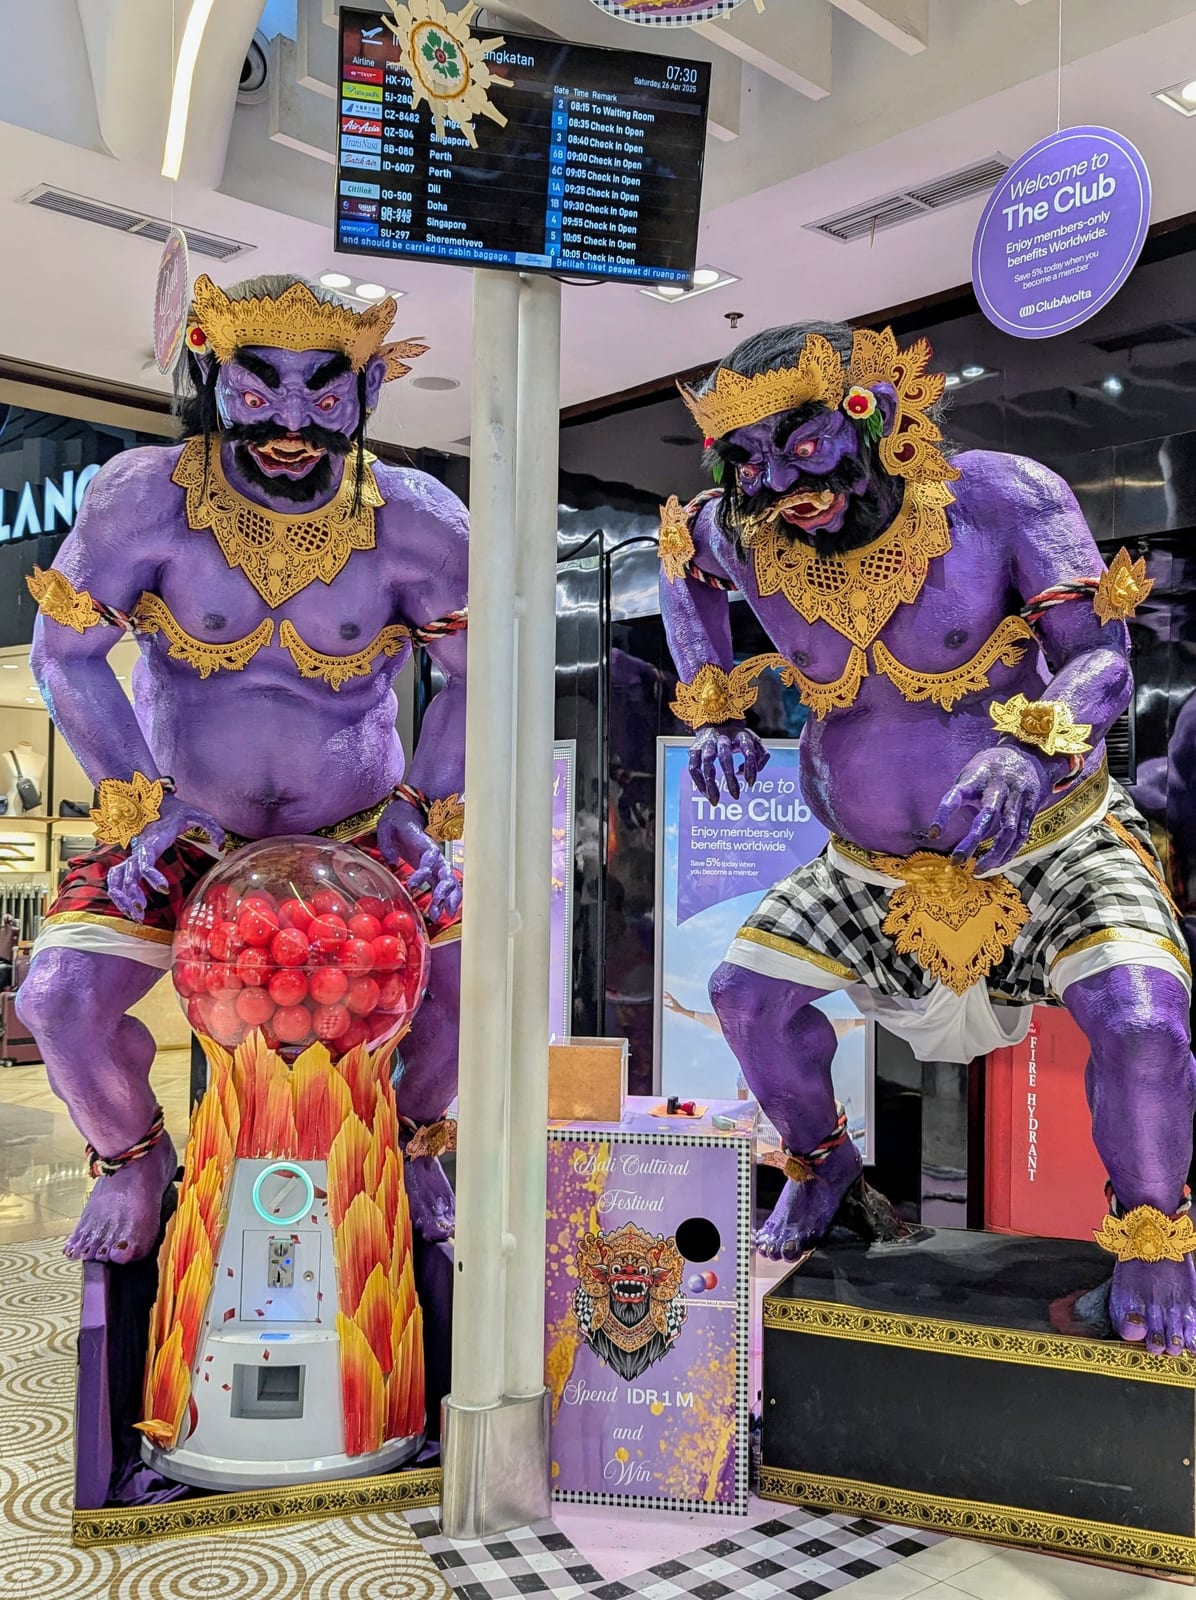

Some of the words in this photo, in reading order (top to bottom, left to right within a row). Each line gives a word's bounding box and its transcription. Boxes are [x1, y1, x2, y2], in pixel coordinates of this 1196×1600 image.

[352, 56, 374, 67] Airline
[666, 66, 698, 83] 07:30
[554, 86, 569, 95] Gate
[574, 88, 589, 97] Time
[592, 91, 617, 102] Remark
[662, 81, 669, 89] 26
[670, 83, 681, 91] Apr
[682, 84, 696, 93] 2025
[385, 92, 412, 104] 5J-280
[385, 110, 419, 123] CZ-8482
[559, 101, 563, 109] 2
[571, 101, 589, 112] 08:15
[592, 105, 601, 114] To
[603, 107, 631, 120] Waiting
[633, 112, 655, 122] Room
[384, 127, 414, 140] QZ-504
[569, 118, 589, 128] 08:35
[591, 122, 614, 133] Check
[616, 125, 623, 134] In
[625, 127, 644, 137] Open
[430, 132, 470, 146] Singapore
[568, 135, 588, 146] 08:40
[590, 138, 613, 149] Check
[615, 142, 622, 150] In
[624, 143, 643, 154] Open
[384, 144, 413, 156] 8B-080
[430, 150, 452, 162] Perth
[383, 161, 415, 173] ID-6007
[553, 150, 563, 158] 6B
[567, 152, 587, 162] 09:00
[589, 155, 612, 166] Check
[614, 158, 621, 167] In
[623, 160, 642, 170] Open
[429, 167, 452, 178] Perth
[552, 167, 562, 175] 6C
[566, 168, 586, 178] 09:05
[588, 172, 611, 182] Check
[613, 174, 619, 183] In
[622, 176, 640, 186] Open
[1011, 161, 1088, 200] Welcome
[1091, 153, 1108, 170] to
[381, 189, 412, 201] QG-500
[428, 184, 441, 193] Dili
[552, 183, 560, 191] 1A
[565, 184, 585, 194] 09:25
[586, 188, 610, 198] Check
[612, 191, 618, 199] In
[620, 192, 639, 202] Open
[427, 201, 447, 212] Doha
[551, 199, 559, 208] 1B
[564, 200, 584, 210] 09:30
[585, 204, 608, 214] Check
[610, 207, 617, 215] In
[619, 208, 638, 218] Open
[1002, 201, 1049, 231] The
[1054, 173, 1116, 212] Club
[427, 217, 466, 230] Singapore
[563, 217, 583, 227] 09:55
[584, 220, 607, 230] Check
[609, 223, 616, 232] In
[618, 224, 636, 234] Open
[380, 229, 410, 240] SU-297
[426, 234, 484, 248] Sheremetyevo
[551, 232, 555, 240] 5
[563, 233, 581, 243] 10:05
[584, 236, 607, 246] Check
[609, 239, 615, 247] In
[618, 240, 636, 250] Open
[1006, 238, 1033, 254] Enjoy
[1034, 211, 1110, 244] members-only
[343, 236, 358, 245] and
[361, 237, 390, 248] should
[392, 241, 402, 249] be
[405, 243, 435, 252] carried
[438, 245, 446, 254] in
[448, 246, 471, 257] cabin
[1008, 247, 1048, 268] benefits
[1049, 228, 1108, 254] Worldwide.
[550, 248, 555, 256] 6
[562, 249, 580, 258] 10:05
[583, 252, 606, 262] Check
[608, 255, 614, 264] In
[557, 259, 584, 269] Belilah
[588, 263, 606, 272] tiket
[608, 266, 640, 275] pesawat
[643, 268, 650, 276] di
[653, 270, 674, 280] ruang
[1014, 272, 1031, 283] Save
[1032, 266, 1044, 277] 5%
[1044, 262, 1063, 274] today
[1064, 256, 1084, 266] when
[1085, 250, 1099, 262] you
[1023, 276, 1051, 290] become
[1058, 263, 1090, 278] member
[1036, 290, 1092, 312] ClubAvolta
[778, 778, 794, 793] to
[691, 797, 742, 820] The
[748, 798, 811, 822] Club
[692, 826, 719, 839] Enjoy
[720, 828, 794, 840] members-only
[692, 840, 731, 850] benefits
[733, 842, 785, 851] worldwide
[706, 858, 720, 867] 5%
[722, 861, 738, 869] today
[1028, 1036, 1037, 1087] FIRE
[1027, 1093, 1039, 1182] HYDRANT
[574, 1153, 617, 1175] Bali
[620, 1154, 690, 1176] Cultural
[598, 1189, 665, 1213] Festival
[563, 1379, 618, 1405] Spend
[627, 1388, 658, 1405] IDR
[662, 1391, 672, 1406] 1
[676, 1392, 693, 1407] M
[613, 1424, 644, 1440] and
[604, 1458, 653, 1485] Win
